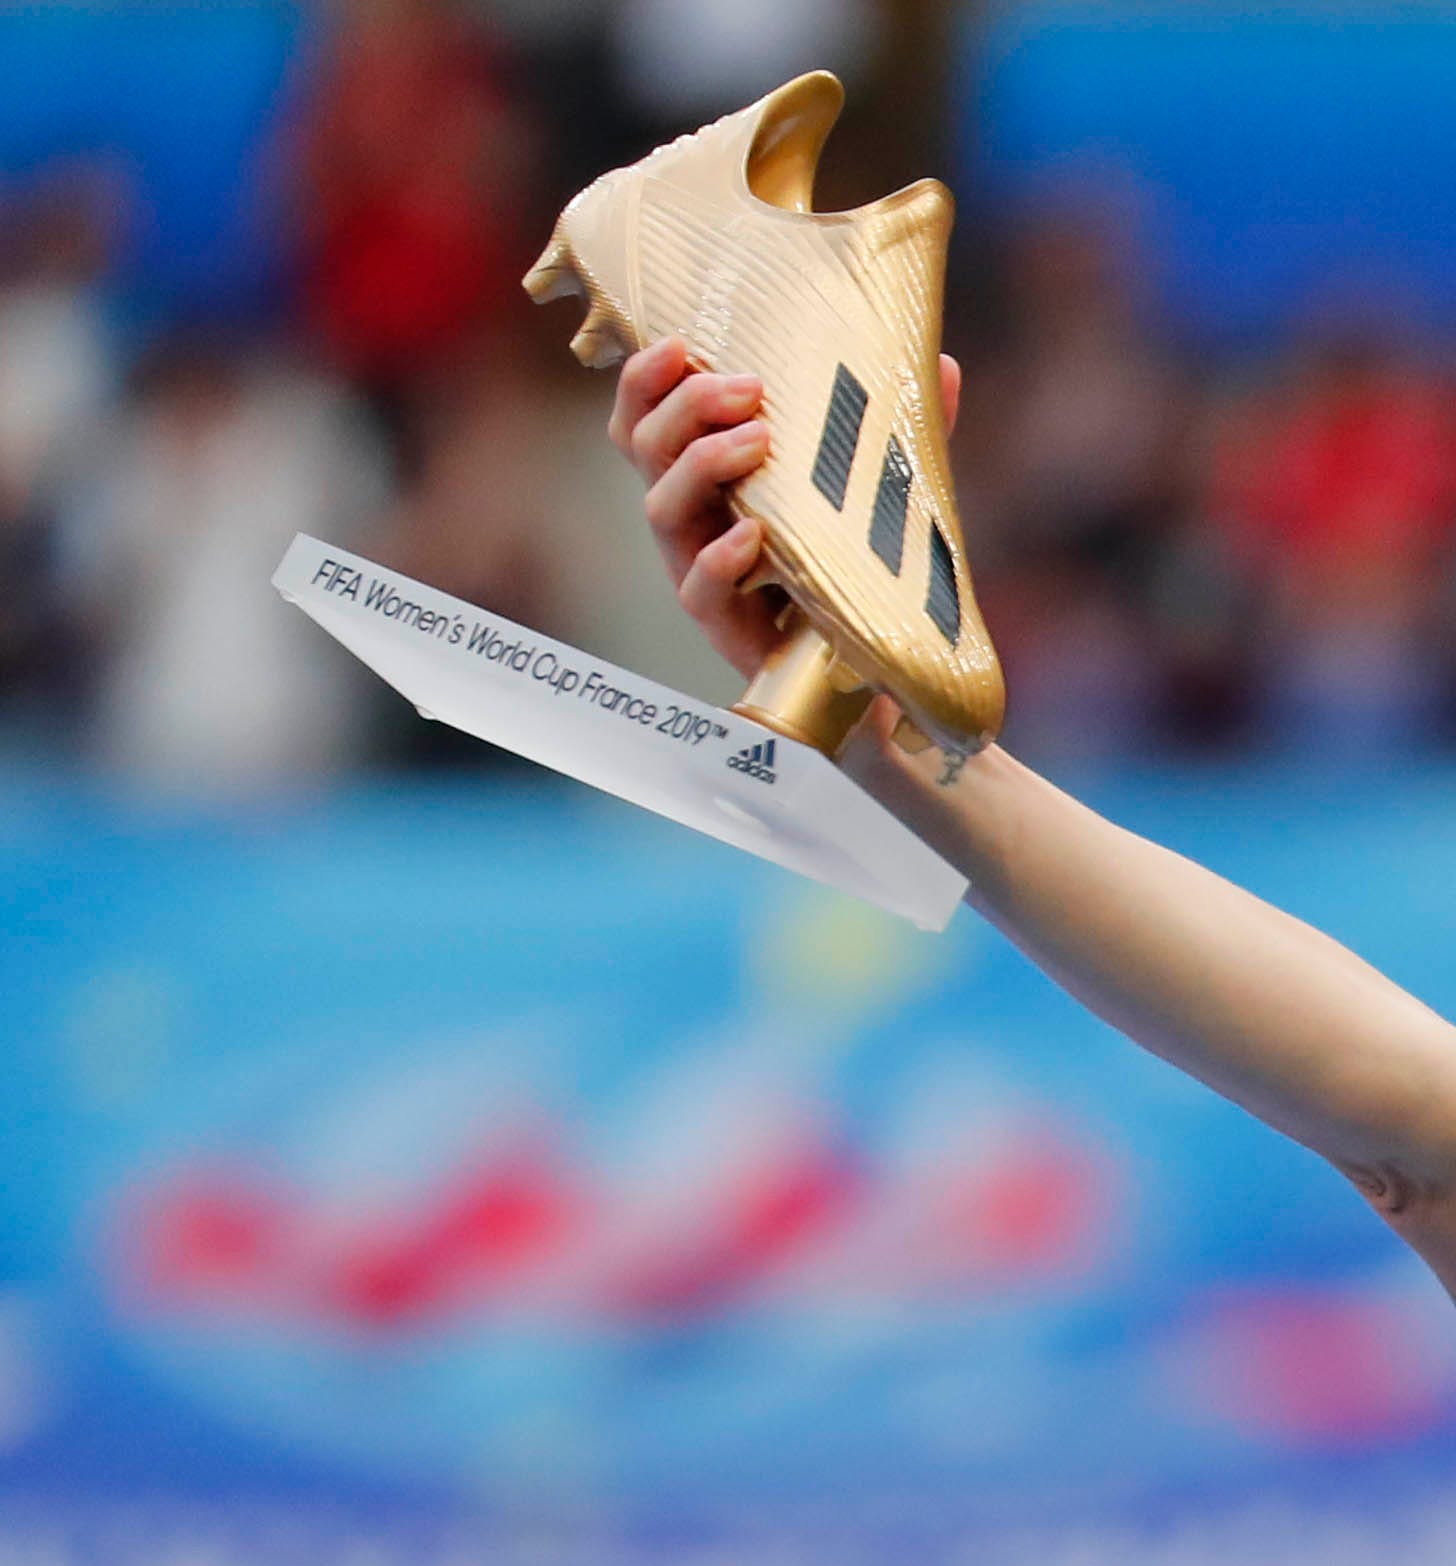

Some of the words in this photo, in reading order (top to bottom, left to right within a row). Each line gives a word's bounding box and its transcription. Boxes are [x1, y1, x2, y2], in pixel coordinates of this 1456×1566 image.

[311, 559, 362, 601] FIFA
[467, 622, 536, 672] World
[532, 652, 580, 696] Cup
[578, 671, 658, 725] France
[726, 756, 777, 785] adidas
